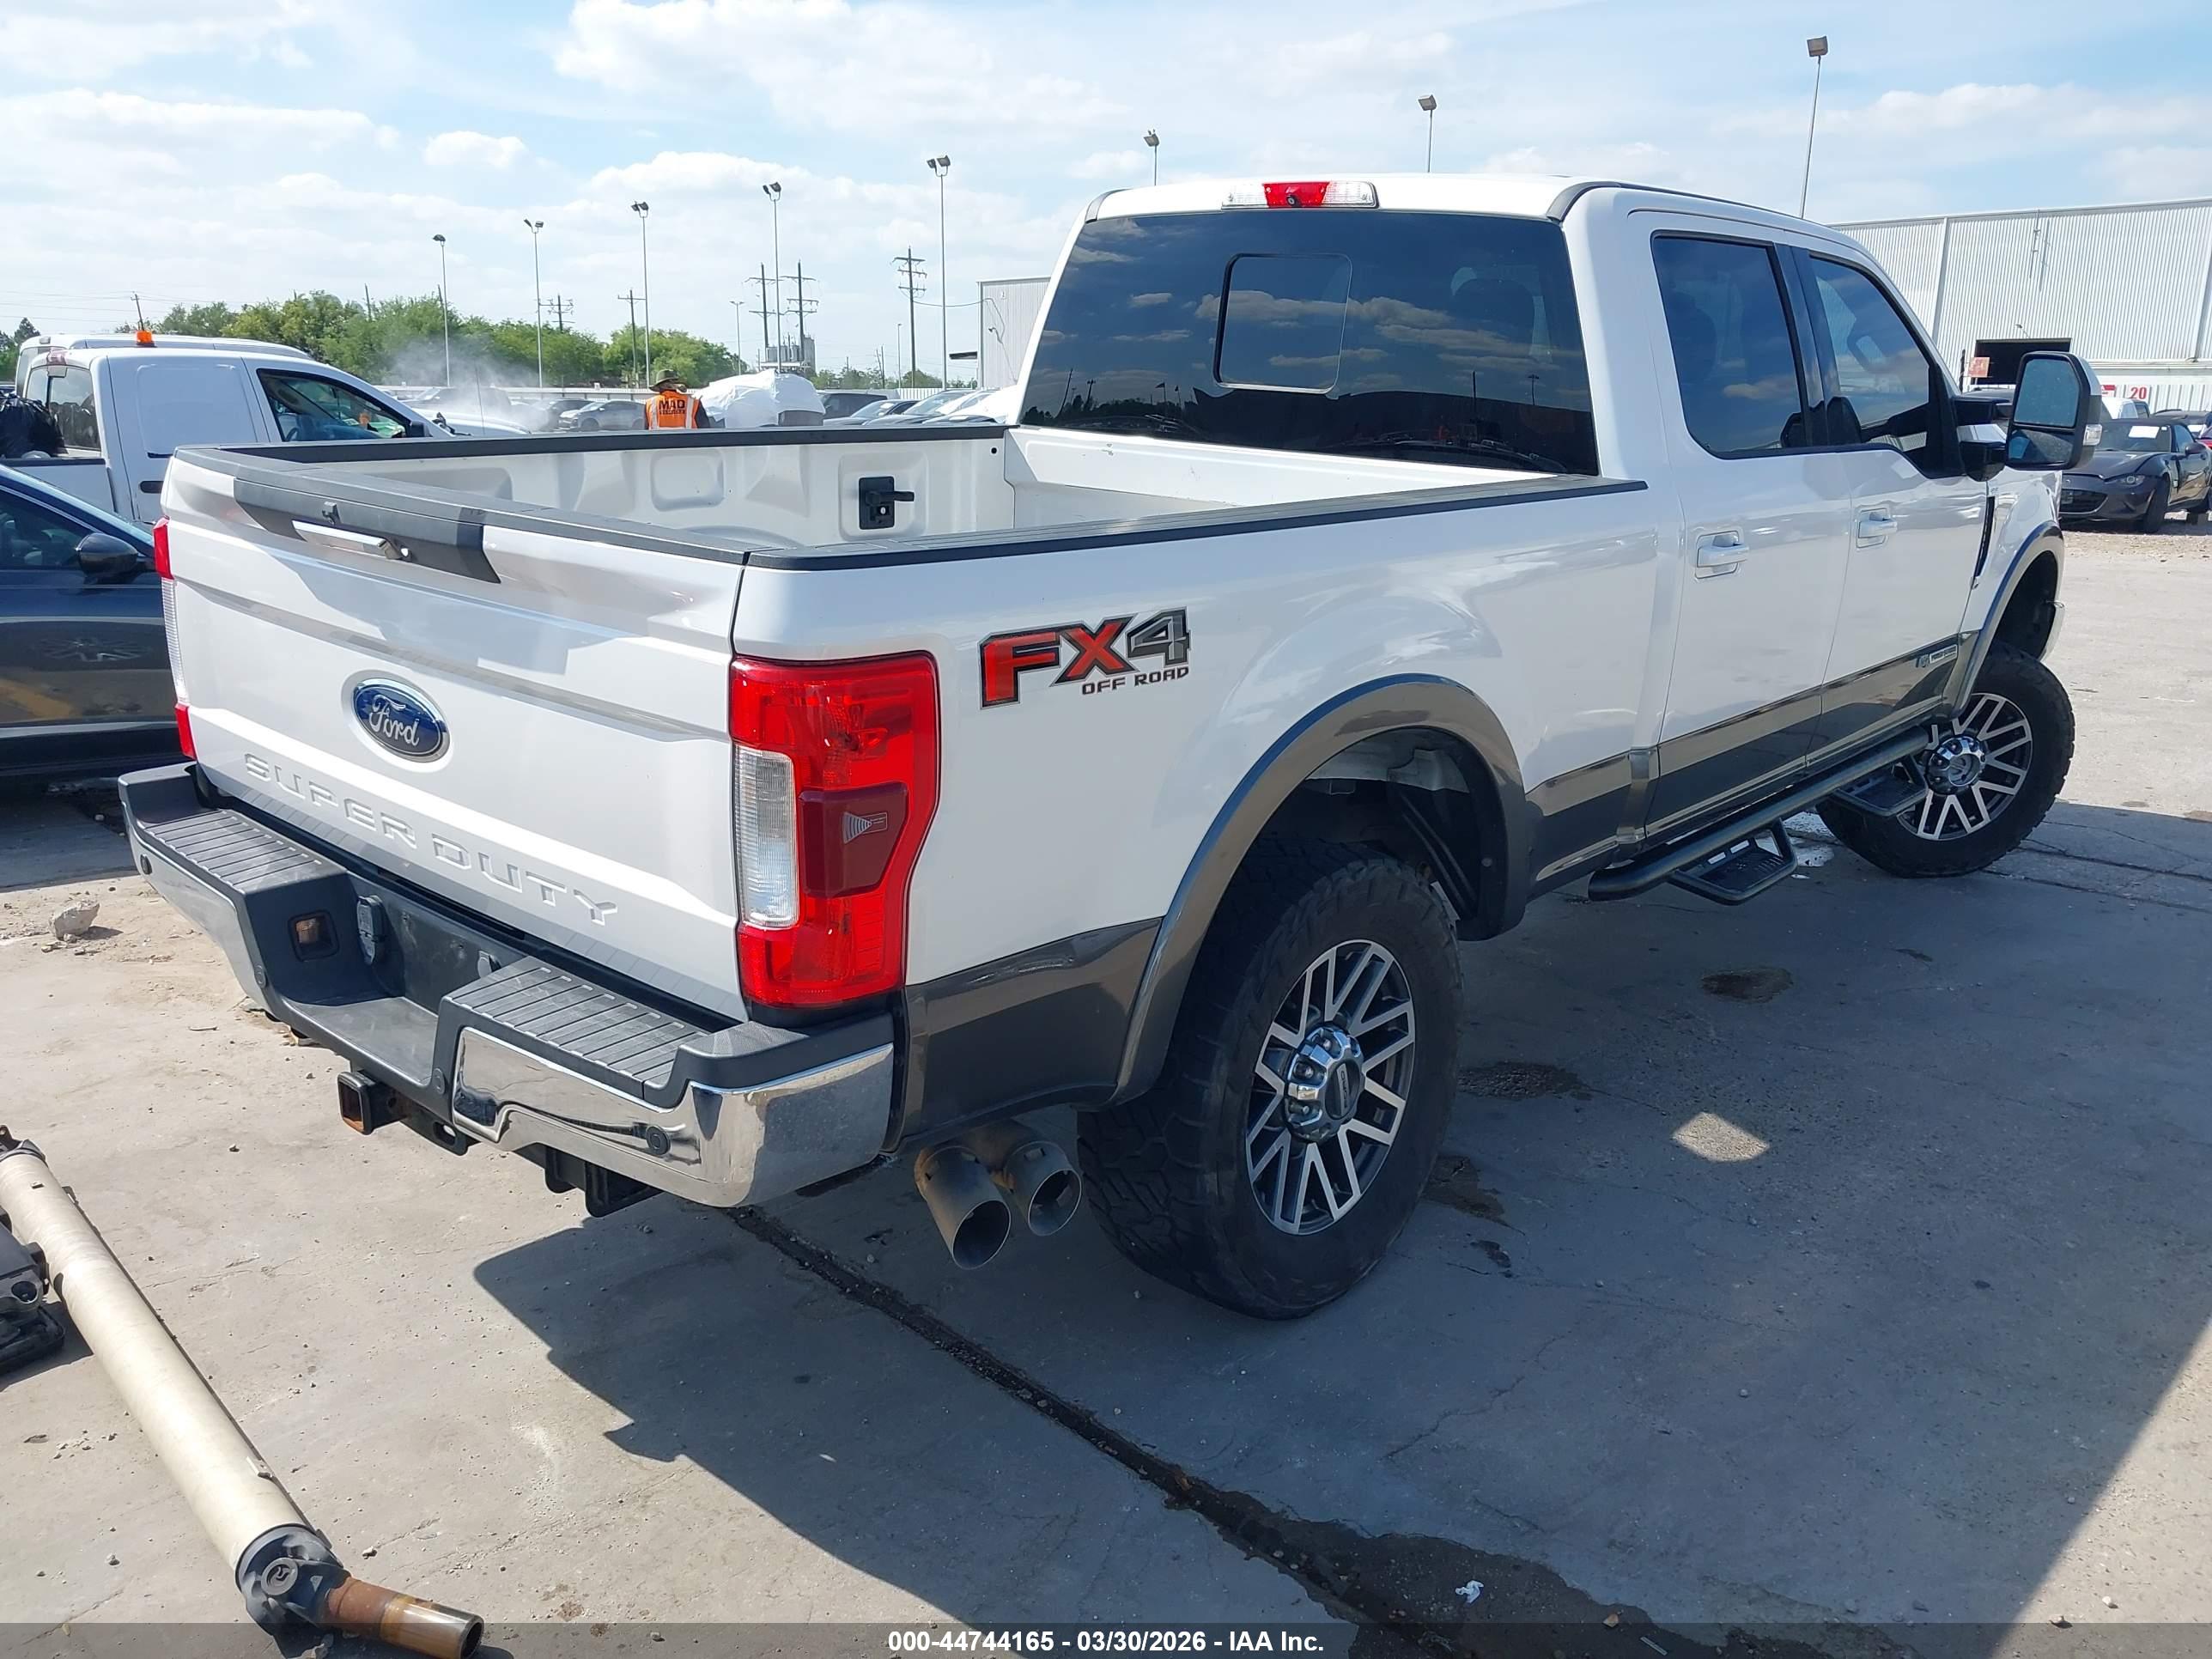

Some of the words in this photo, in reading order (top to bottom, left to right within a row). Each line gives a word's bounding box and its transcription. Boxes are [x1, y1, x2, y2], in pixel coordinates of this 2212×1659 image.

[659, 399, 685, 410] MAD
[2129, 386, 2148, 399] 20
[977, 606, 1192, 709] FX4
[1082, 677, 1126, 695] OFF
[1133, 666, 1189, 686] ROAD
[368, 694, 420, 746] Ford
[244, 752, 417, 849] SUPER
[432, 833, 618, 926] DUTY
